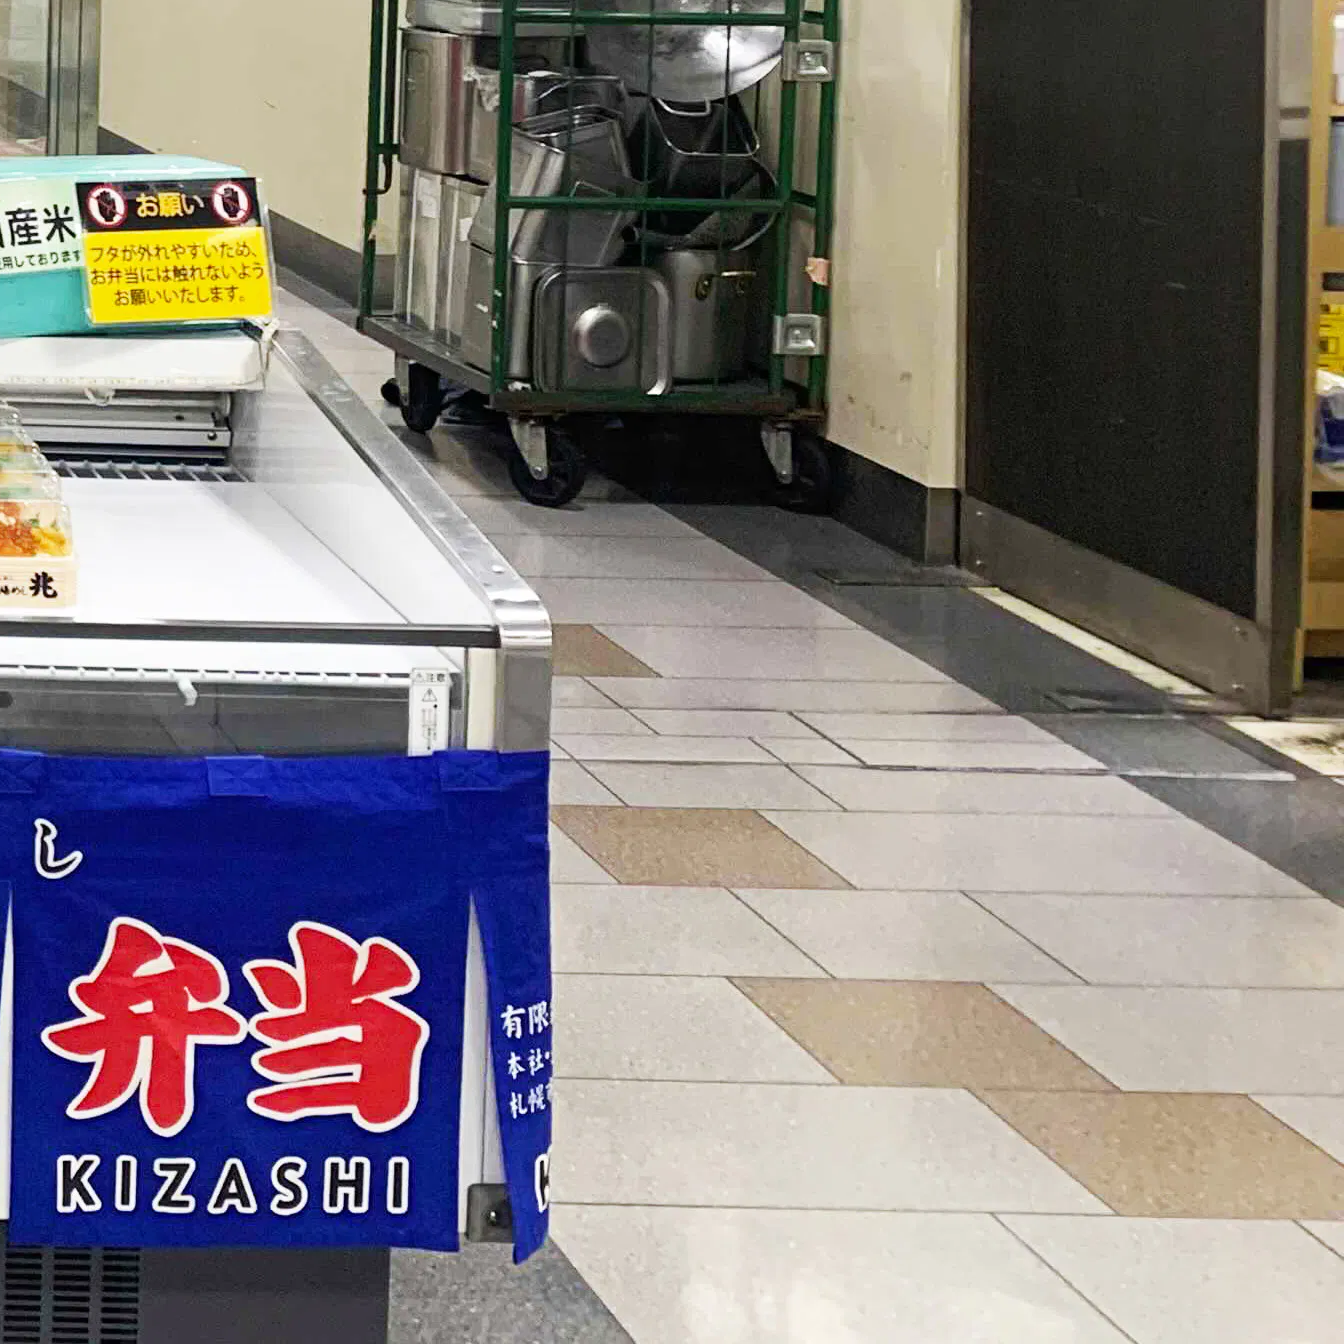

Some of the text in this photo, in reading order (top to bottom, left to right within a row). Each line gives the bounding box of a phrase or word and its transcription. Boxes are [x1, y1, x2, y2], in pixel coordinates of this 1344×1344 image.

[136, 190, 205, 219] お願い
[90, 244, 259, 265] フタが外れやすいため、
[90, 262, 265, 286] お弁当には触れないよう
[113, 286, 246, 308] お願いいたします。
[29, 570, 58, 599] 兆
[40, 916, 430, 1137] 弁当
[55, 1152, 410, 1216] KIZASHI
